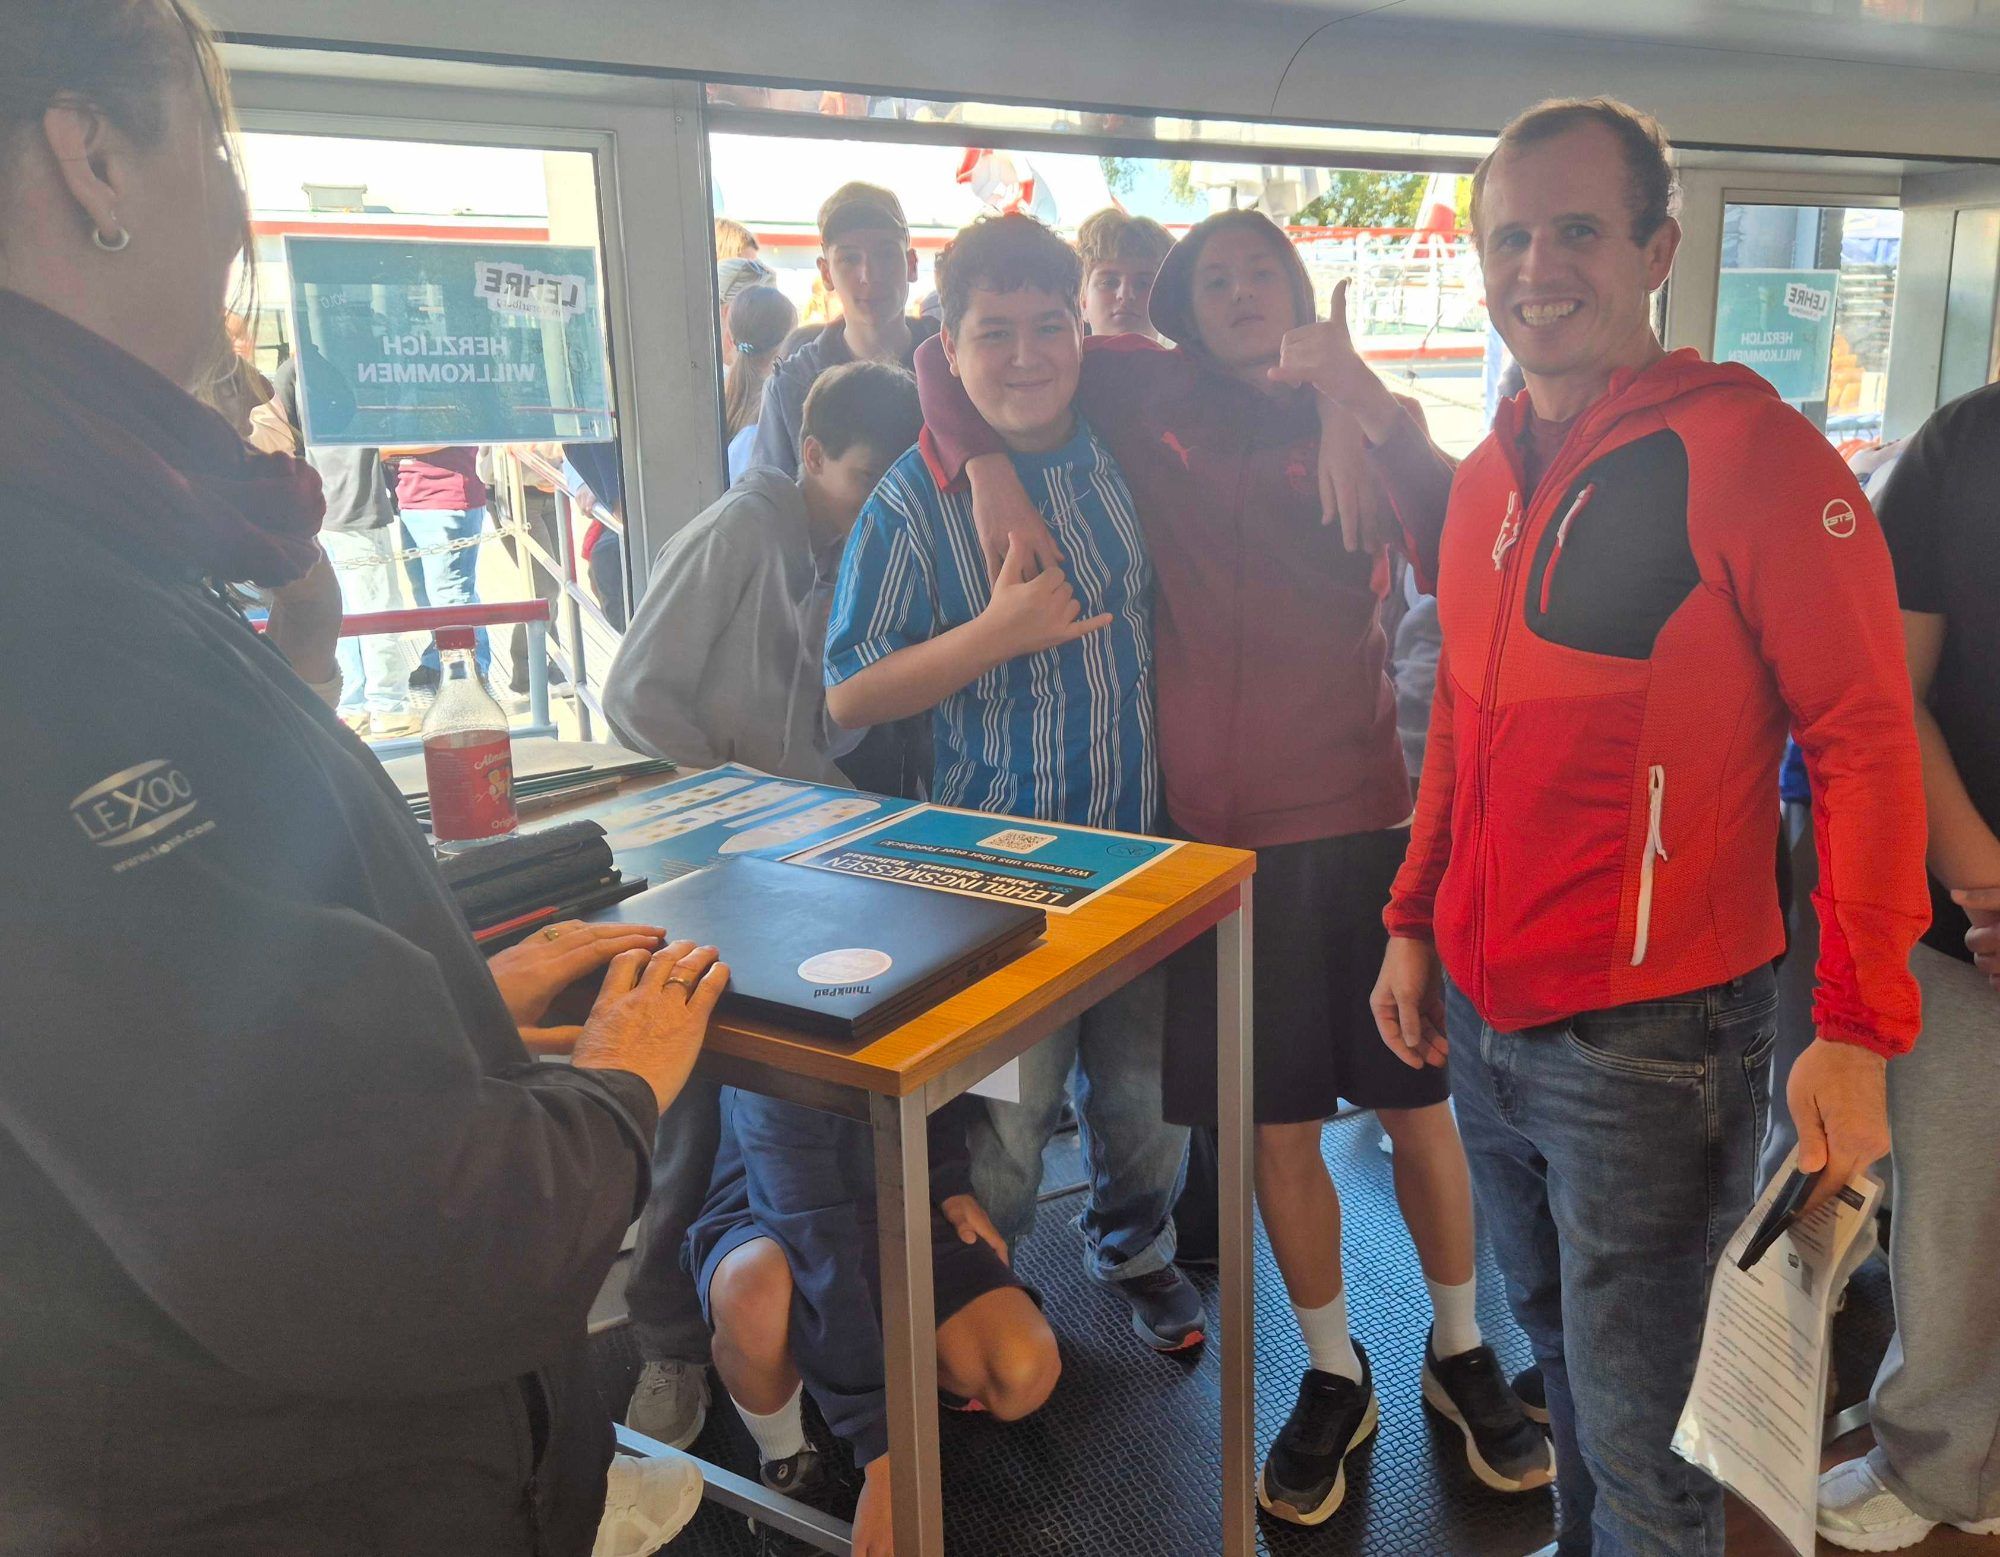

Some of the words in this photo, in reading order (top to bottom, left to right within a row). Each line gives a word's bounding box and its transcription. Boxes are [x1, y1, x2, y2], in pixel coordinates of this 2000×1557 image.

[940, 847, 968, 856] euer
[969, 851, 997, 862] über
[842, 852, 910, 867] Hallenbad
[998, 856, 1021, 866] uns
[915, 863, 985, 879] Spinnsaal
[1024, 861, 1063, 872] freuen
[1065, 867, 1090, 877] Wir
[822, 856, 1065, 904] LEHRLINGSMESSEN
[813, 985, 872, 998] ThinkPad
